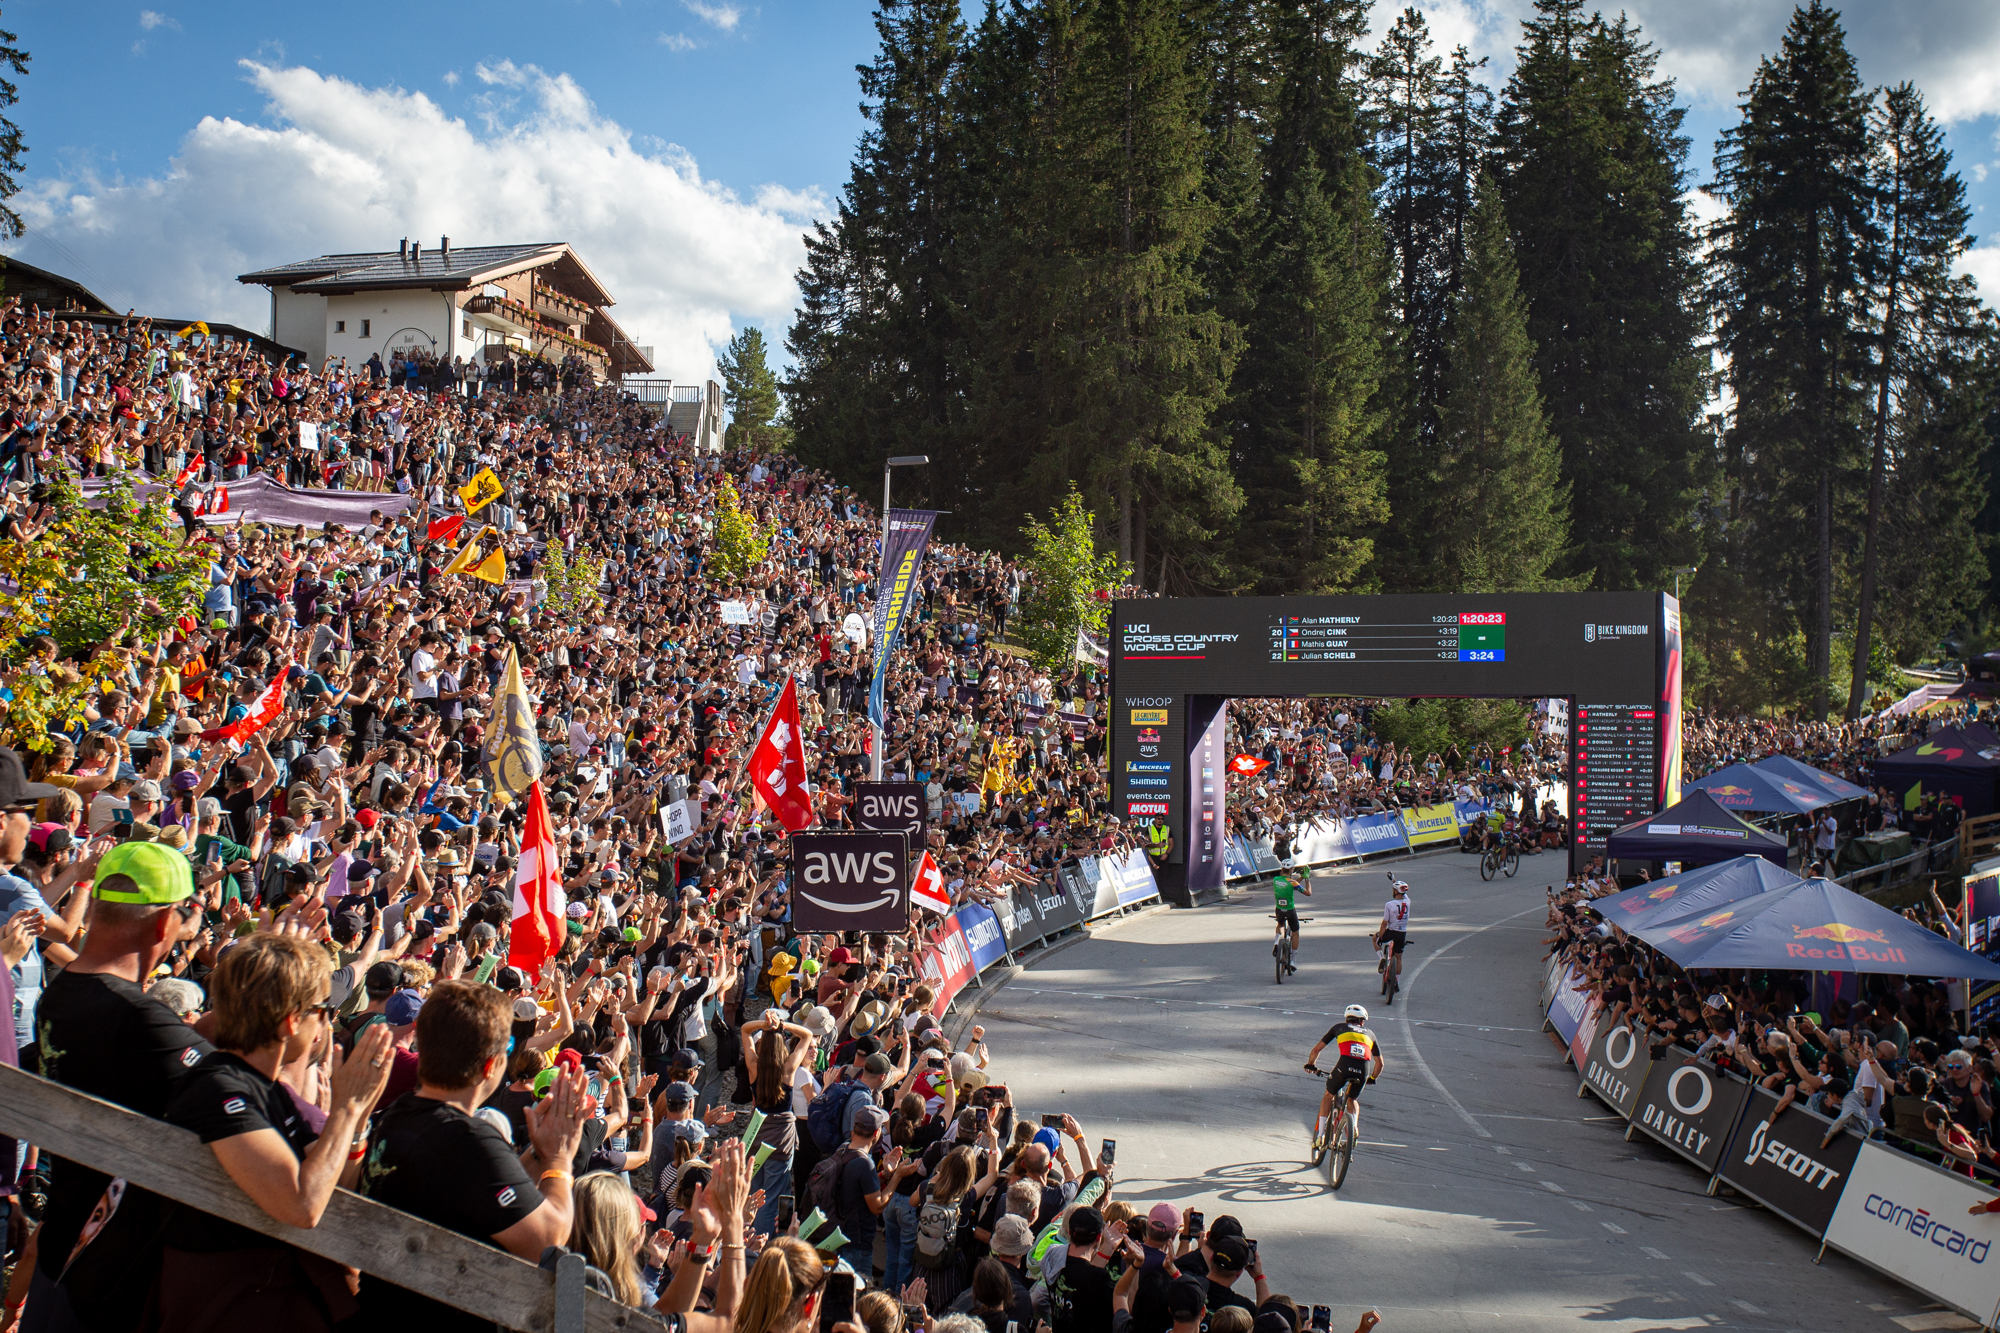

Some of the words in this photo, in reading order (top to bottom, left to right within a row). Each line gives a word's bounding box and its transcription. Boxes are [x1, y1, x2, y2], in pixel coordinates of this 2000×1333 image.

[879, 587, 893, 622] SERIES
[1462, 614, 1502, 623] 1:20:23
[1128, 624, 1149, 633] UCI
[1301, 629, 1325, 637] Ondrej
[1597, 625, 1613, 635] BIKE
[1615, 625, 1648, 634] KINGDOM
[1123, 635, 1171, 643] CROSS
[1174, 634, 1239, 642] COUNTRY
[1123, 643, 1174, 651] WORLD
[1469, 651, 1494, 660] 3:24
[1125, 697, 1172, 707] WHOOP
[1140, 745, 1158, 753] aws
[1130, 778, 1167, 786] SHIMANO
[1126, 792, 1171, 800] events.com
[1724, 796, 1754, 806] Bull
[863, 795, 919, 817] aws
[1130, 804, 1167, 814] MOTUL
[1416, 815, 1452, 829] MICHELIN
[1352, 823, 1399, 844] SHIMANO
[803, 851, 896, 884] aws
[966, 916, 1000, 952] SHIMANO
[1785, 943, 1846, 959] Red
[1848, 945, 1907, 963] Bull
[1588, 1061, 1630, 1104] OAKLEY
[1642, 1103, 1709, 1155] OAKLEY
[1762, 1140, 1840, 1191] SCOTT
